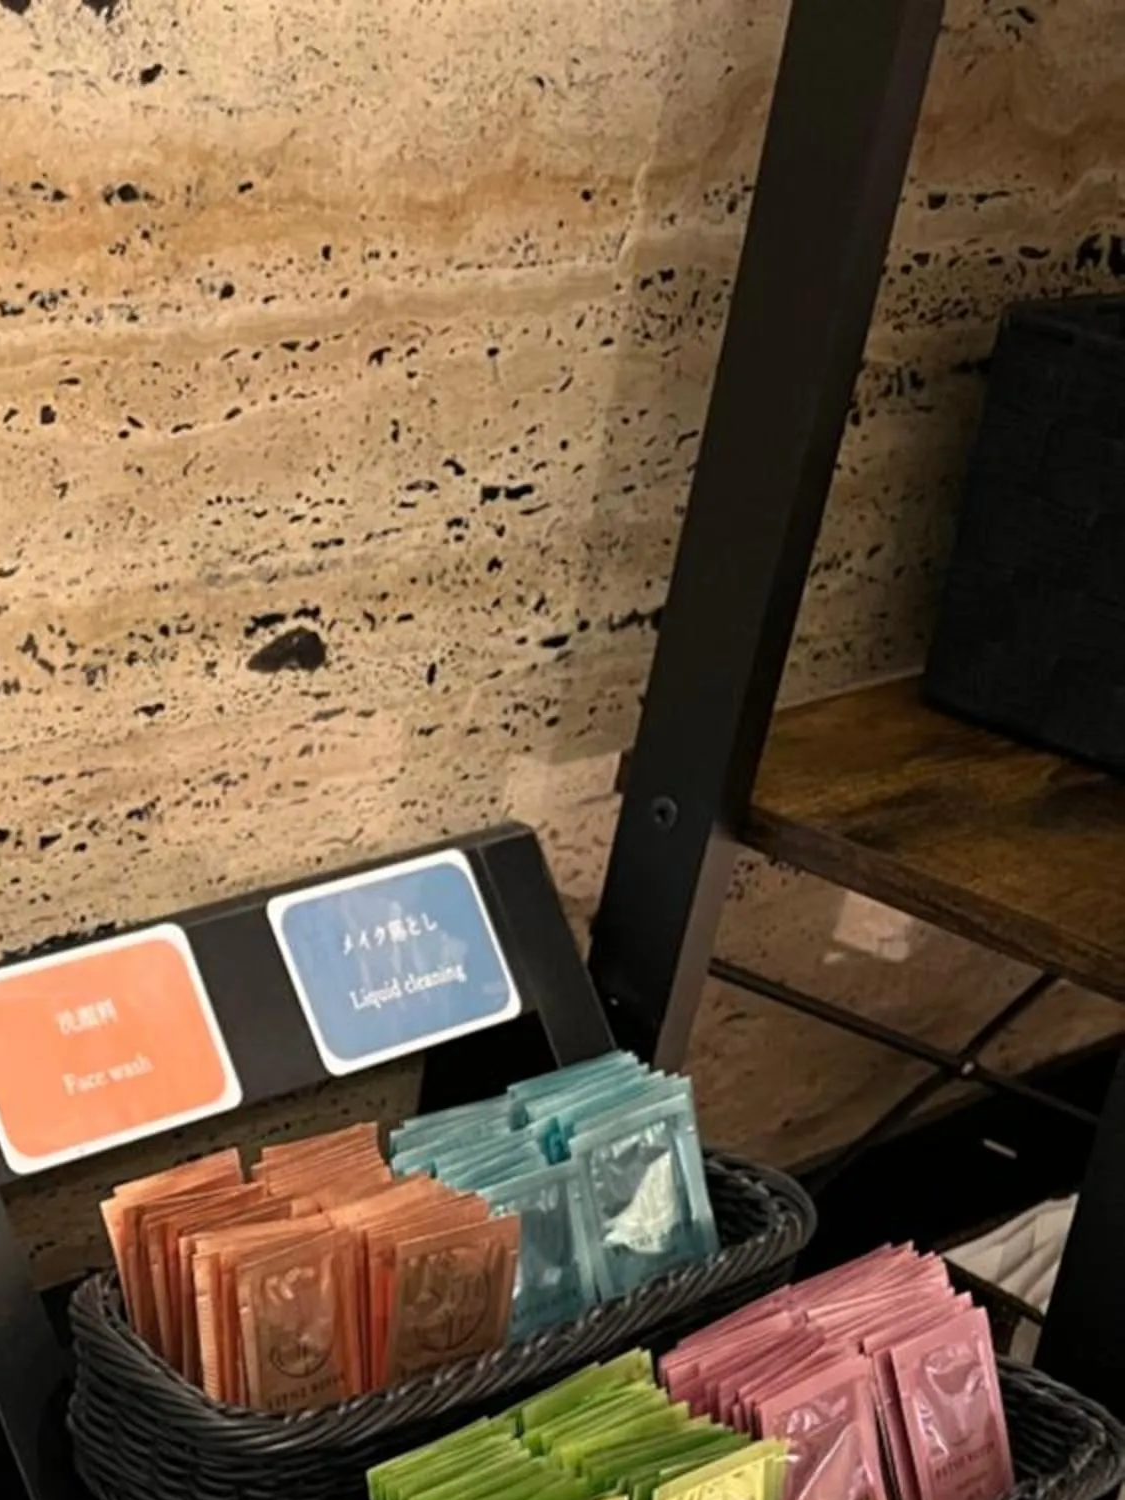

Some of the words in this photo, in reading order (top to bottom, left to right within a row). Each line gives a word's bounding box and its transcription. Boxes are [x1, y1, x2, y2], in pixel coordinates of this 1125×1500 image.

[349, 977, 401, 1012] Liquid
[405, 961, 465, 998] cleaning
[62, 1071, 105, 1097] Face
[110, 1054, 153, 1083] wash
